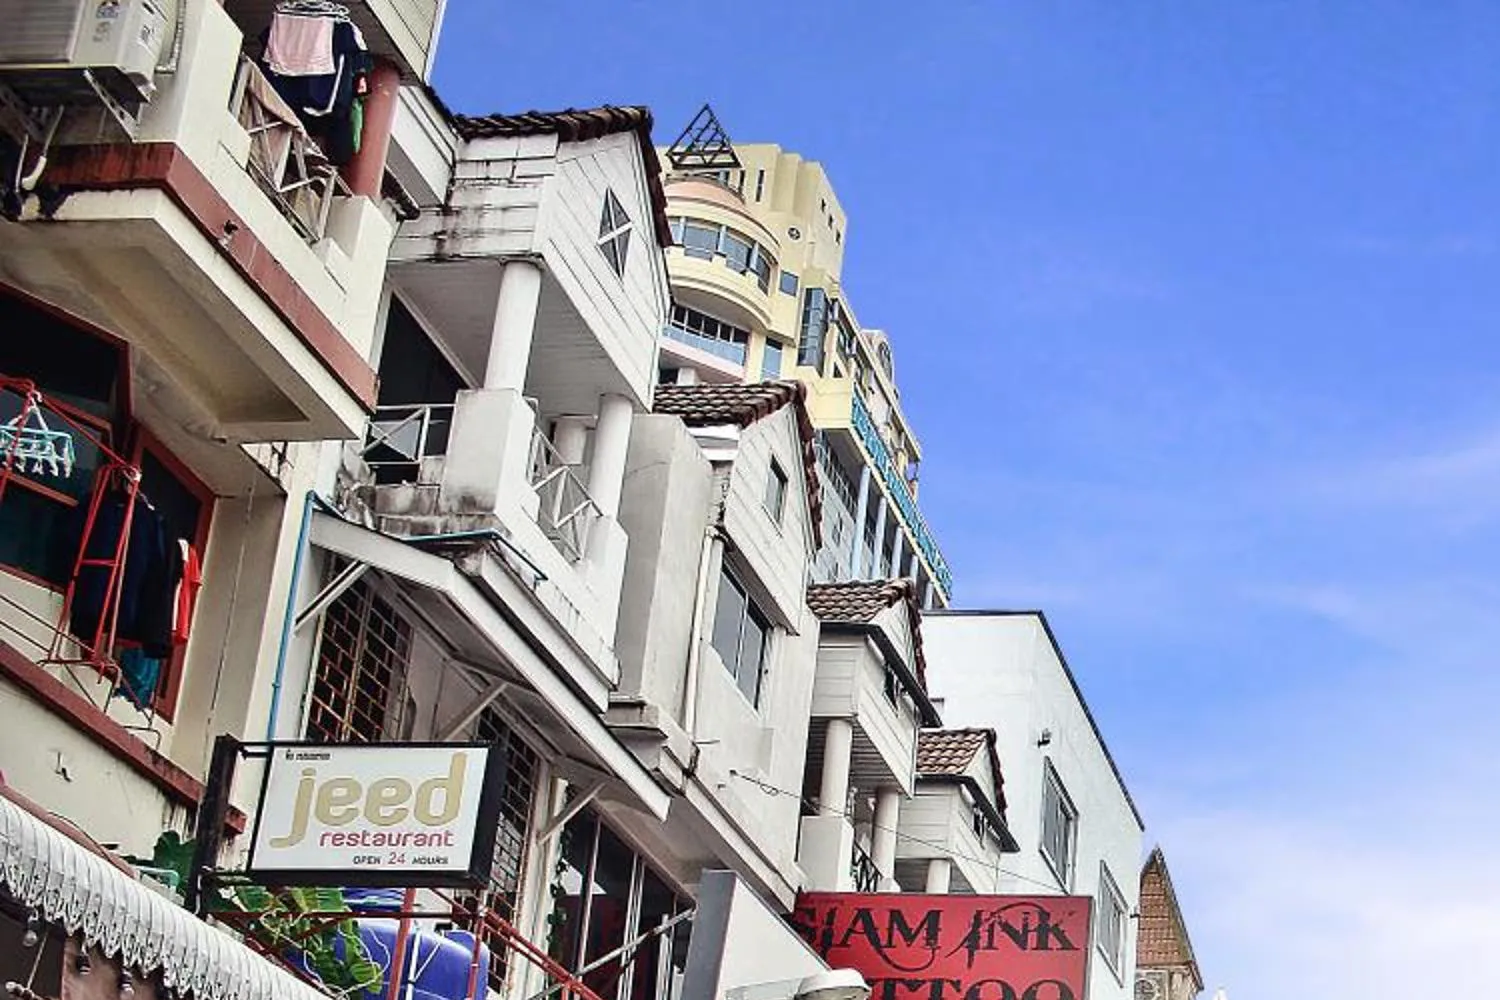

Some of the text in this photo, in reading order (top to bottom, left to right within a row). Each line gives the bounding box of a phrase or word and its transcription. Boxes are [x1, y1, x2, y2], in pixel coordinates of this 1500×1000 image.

[269, 751, 468, 849] jeed
[319, 830, 454, 847] restaurant
[353, 856, 381, 865] OPEN
[387, 851, 406, 865] 24
